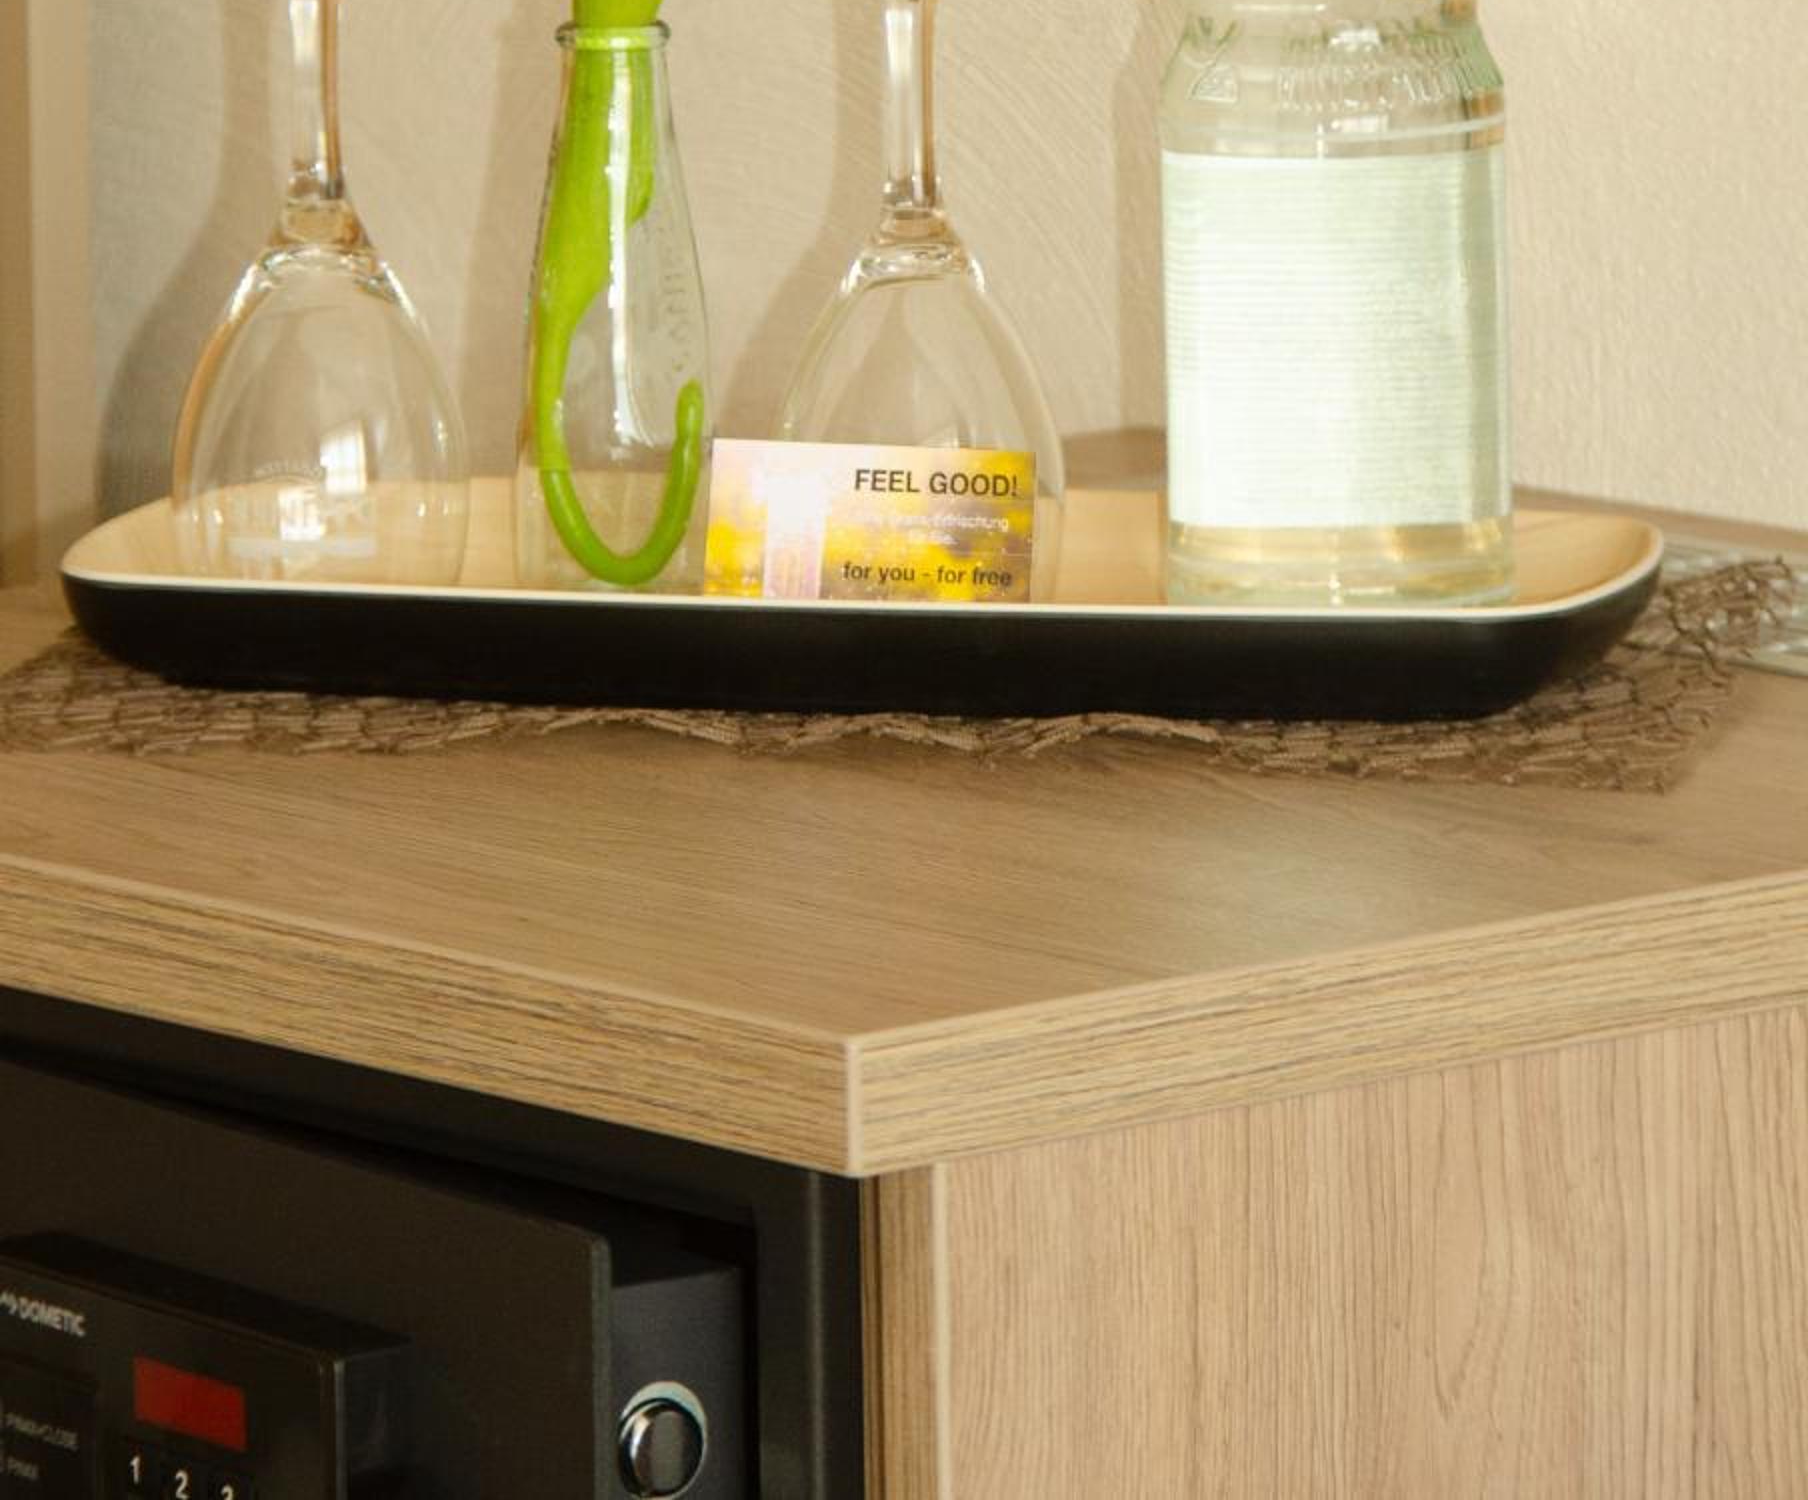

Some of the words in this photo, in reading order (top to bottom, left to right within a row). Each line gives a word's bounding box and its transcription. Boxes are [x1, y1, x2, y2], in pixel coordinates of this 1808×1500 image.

[853, 468, 920, 493] FEEL
[929, 472, 1019, 497] GOOD!
[843, 561, 870, 581] for
[878, 565, 915, 583] you
[937, 564, 964, 584] for
[972, 566, 1012, 588] free
[18, 1296, 86, 1338] DOMETIC
[129, 1455, 141, 1485] 1
[175, 1469, 190, 1500] 2
